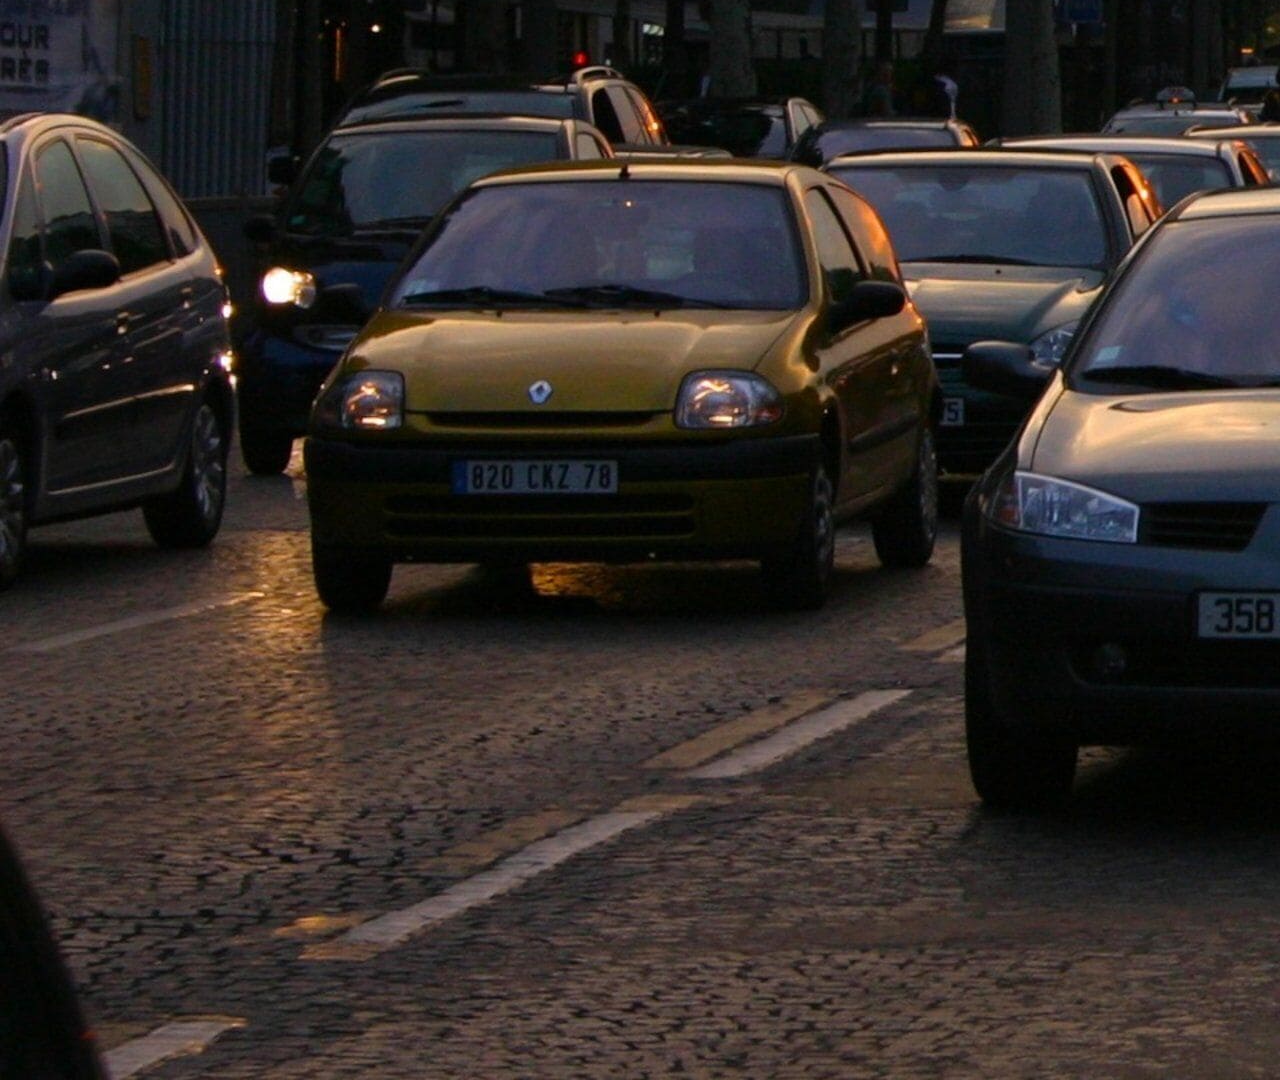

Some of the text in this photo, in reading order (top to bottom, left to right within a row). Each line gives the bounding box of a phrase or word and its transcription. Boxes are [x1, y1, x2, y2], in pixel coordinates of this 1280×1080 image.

[472, 464, 611, 489] 820 CKZ 78
[1214, 598, 1274, 634] 358
